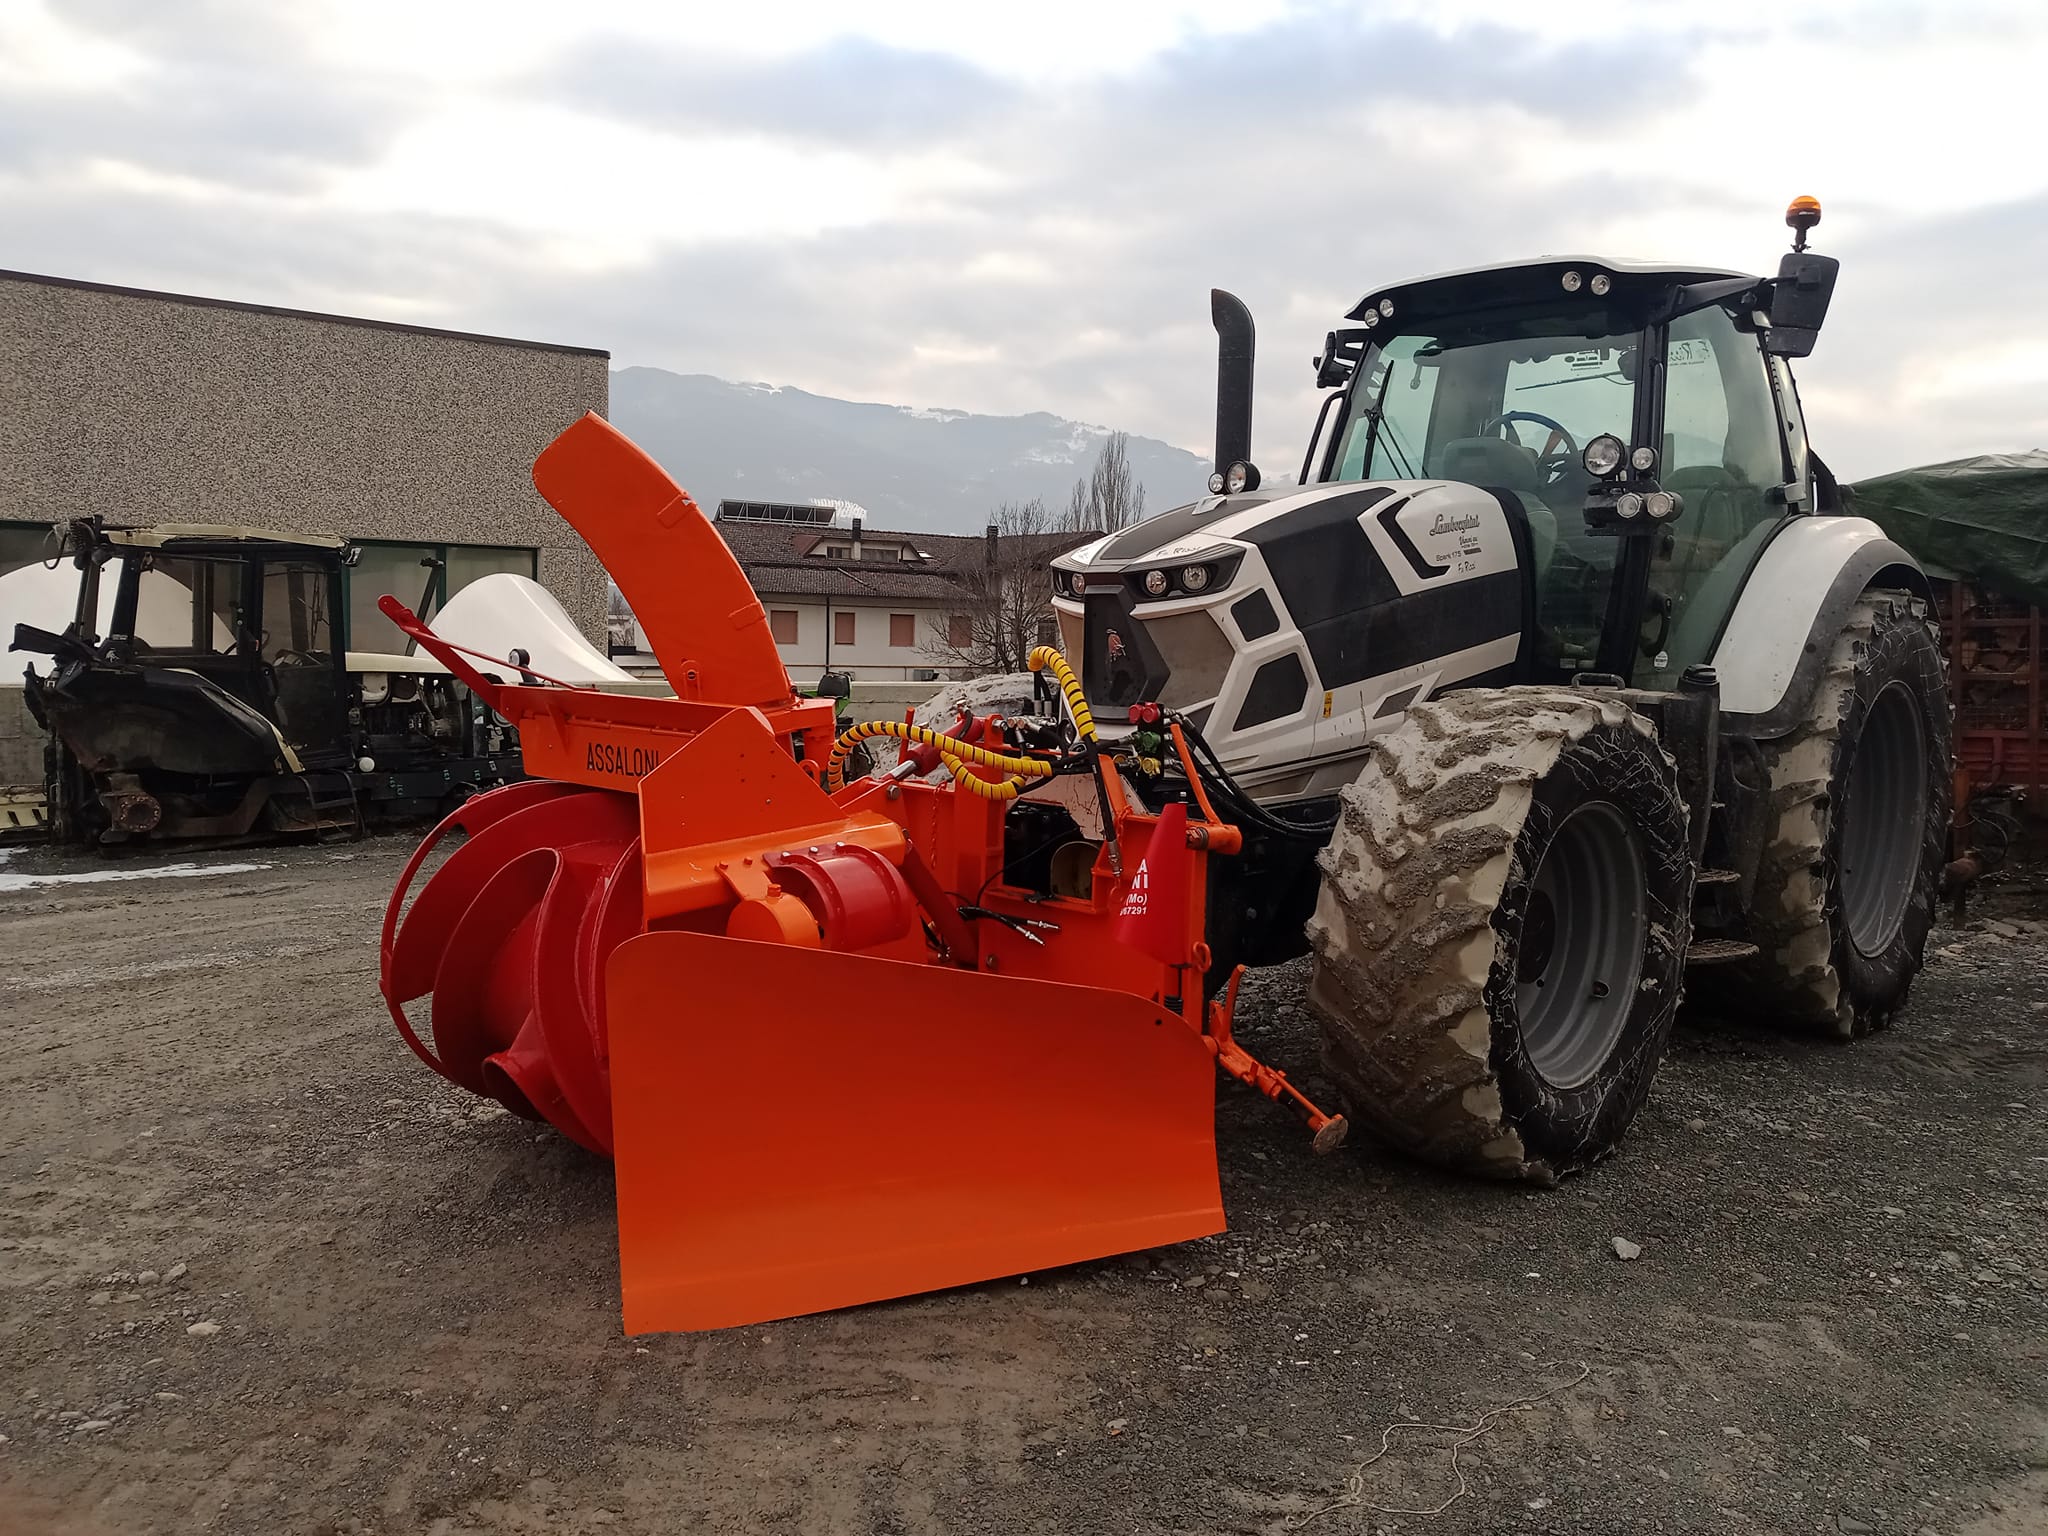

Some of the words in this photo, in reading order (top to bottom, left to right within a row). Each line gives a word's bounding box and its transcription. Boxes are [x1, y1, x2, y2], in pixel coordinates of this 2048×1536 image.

[1429, 513, 1480, 536] Lamborghini
[586, 742, 659, 777] ASSALONI
[1126, 893, 1148, 907] (Mo)
